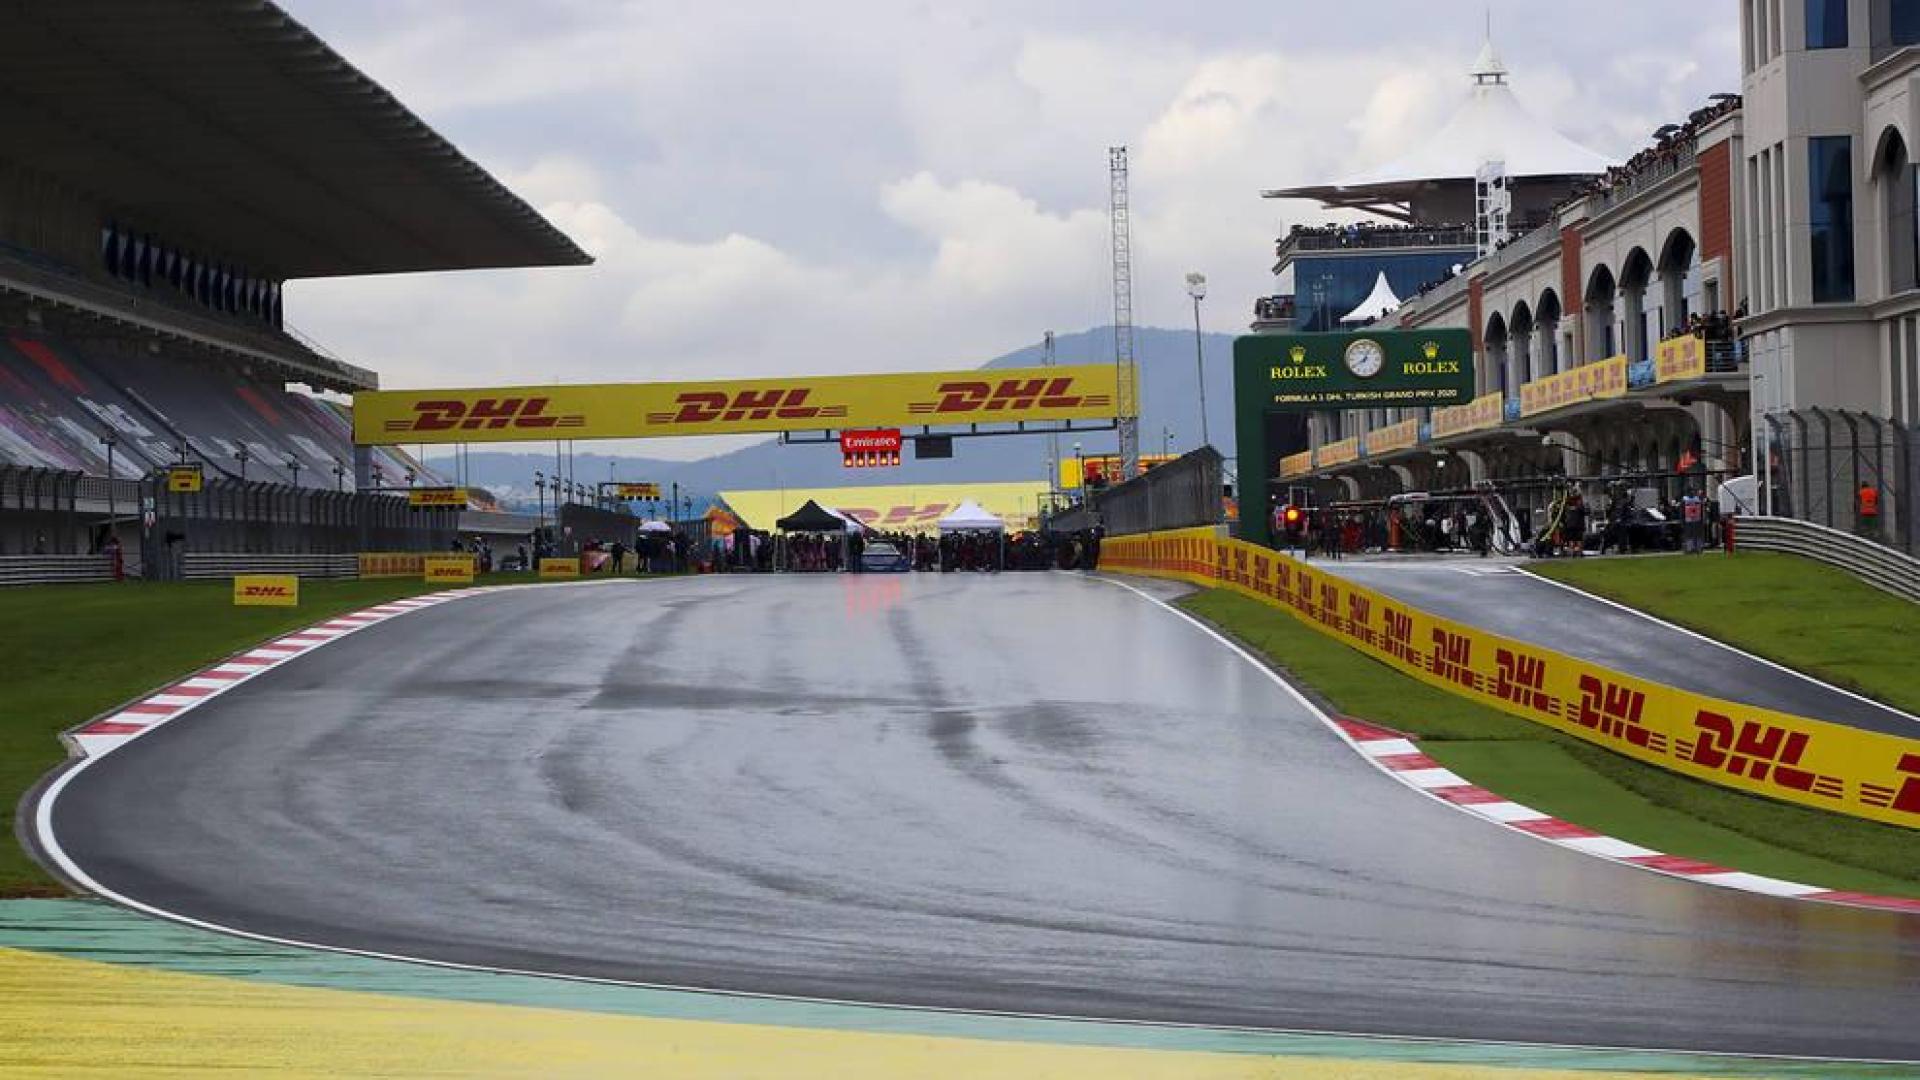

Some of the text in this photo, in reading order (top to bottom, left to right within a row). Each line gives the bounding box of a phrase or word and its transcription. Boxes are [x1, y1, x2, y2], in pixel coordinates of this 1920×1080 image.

[1271, 364, 1328, 380] ROLEX
[1403, 360, 1461, 375] ROLEX
[674, 388, 821, 424] DHL
[936, 377, 1085, 413] DHL
[1436, 388, 1458, 398] 2020
[413, 397, 560, 431] DHL
[845, 434, 898, 449] Emirates
[244, 586, 287, 596] DHL
[1432, 627, 1474, 688] DHL
[1496, 648, 1551, 712] DHL
[1579, 674, 1651, 749] DHL
[1692, 709, 1816, 792] DHL
